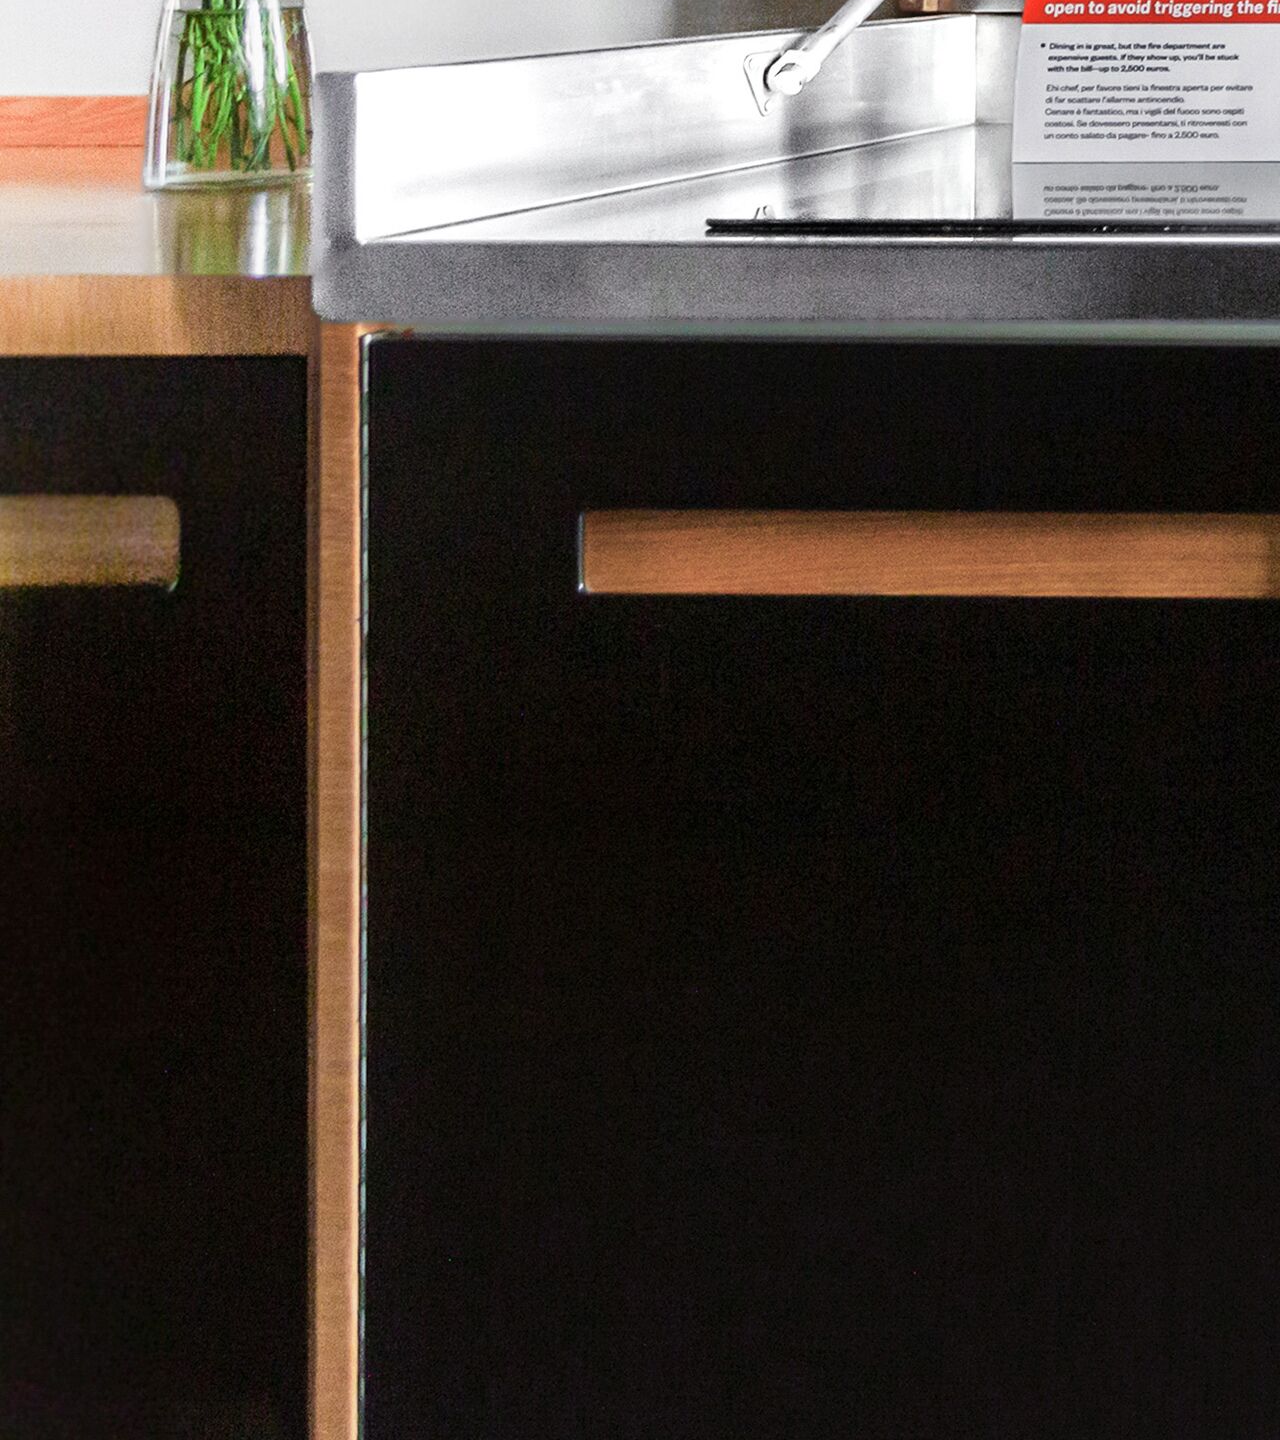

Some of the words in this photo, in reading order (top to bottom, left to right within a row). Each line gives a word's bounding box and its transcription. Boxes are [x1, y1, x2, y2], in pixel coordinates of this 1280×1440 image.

[1044, 3, 1085, 17] open
[1088, 0, 1105, 15] to
[1107, 0, 1152, 15] avoid
[1154, 0, 1234, 17] triggering
[1236, 0, 1264, 15] the
[1049, 42, 1075, 51] Dining
[1076, 42, 1085, 50] in
[1085, 42, 1092, 50] is
[1093, 42, 1117, 51] great,
[1118, 42, 1132, 50] but
[1133, 42, 1147, 50] the
[1148, 42, 1161, 50] fire
[1162, 42, 1211, 51] department
[1127, 54, 1145, 62] they
[1046, 84, 1059, 92] Ehi
[1060, 84, 1080, 93] chef,
[1080, 85, 1095, 93] per
[1096, 84, 1122, 92] favore
[1123, 84, 1141, 92] tieni
[1141, 84, 1149, 92] la
[1150, 84, 1181, 92] finestra
[1182, 84, 1209, 92] aperta
[1225, 84, 1254, 92] evitare
[1045, 96, 1053, 104] di
[1054, 96, 1067, 104] far
[1067, 96, 1101, 104] scattare
